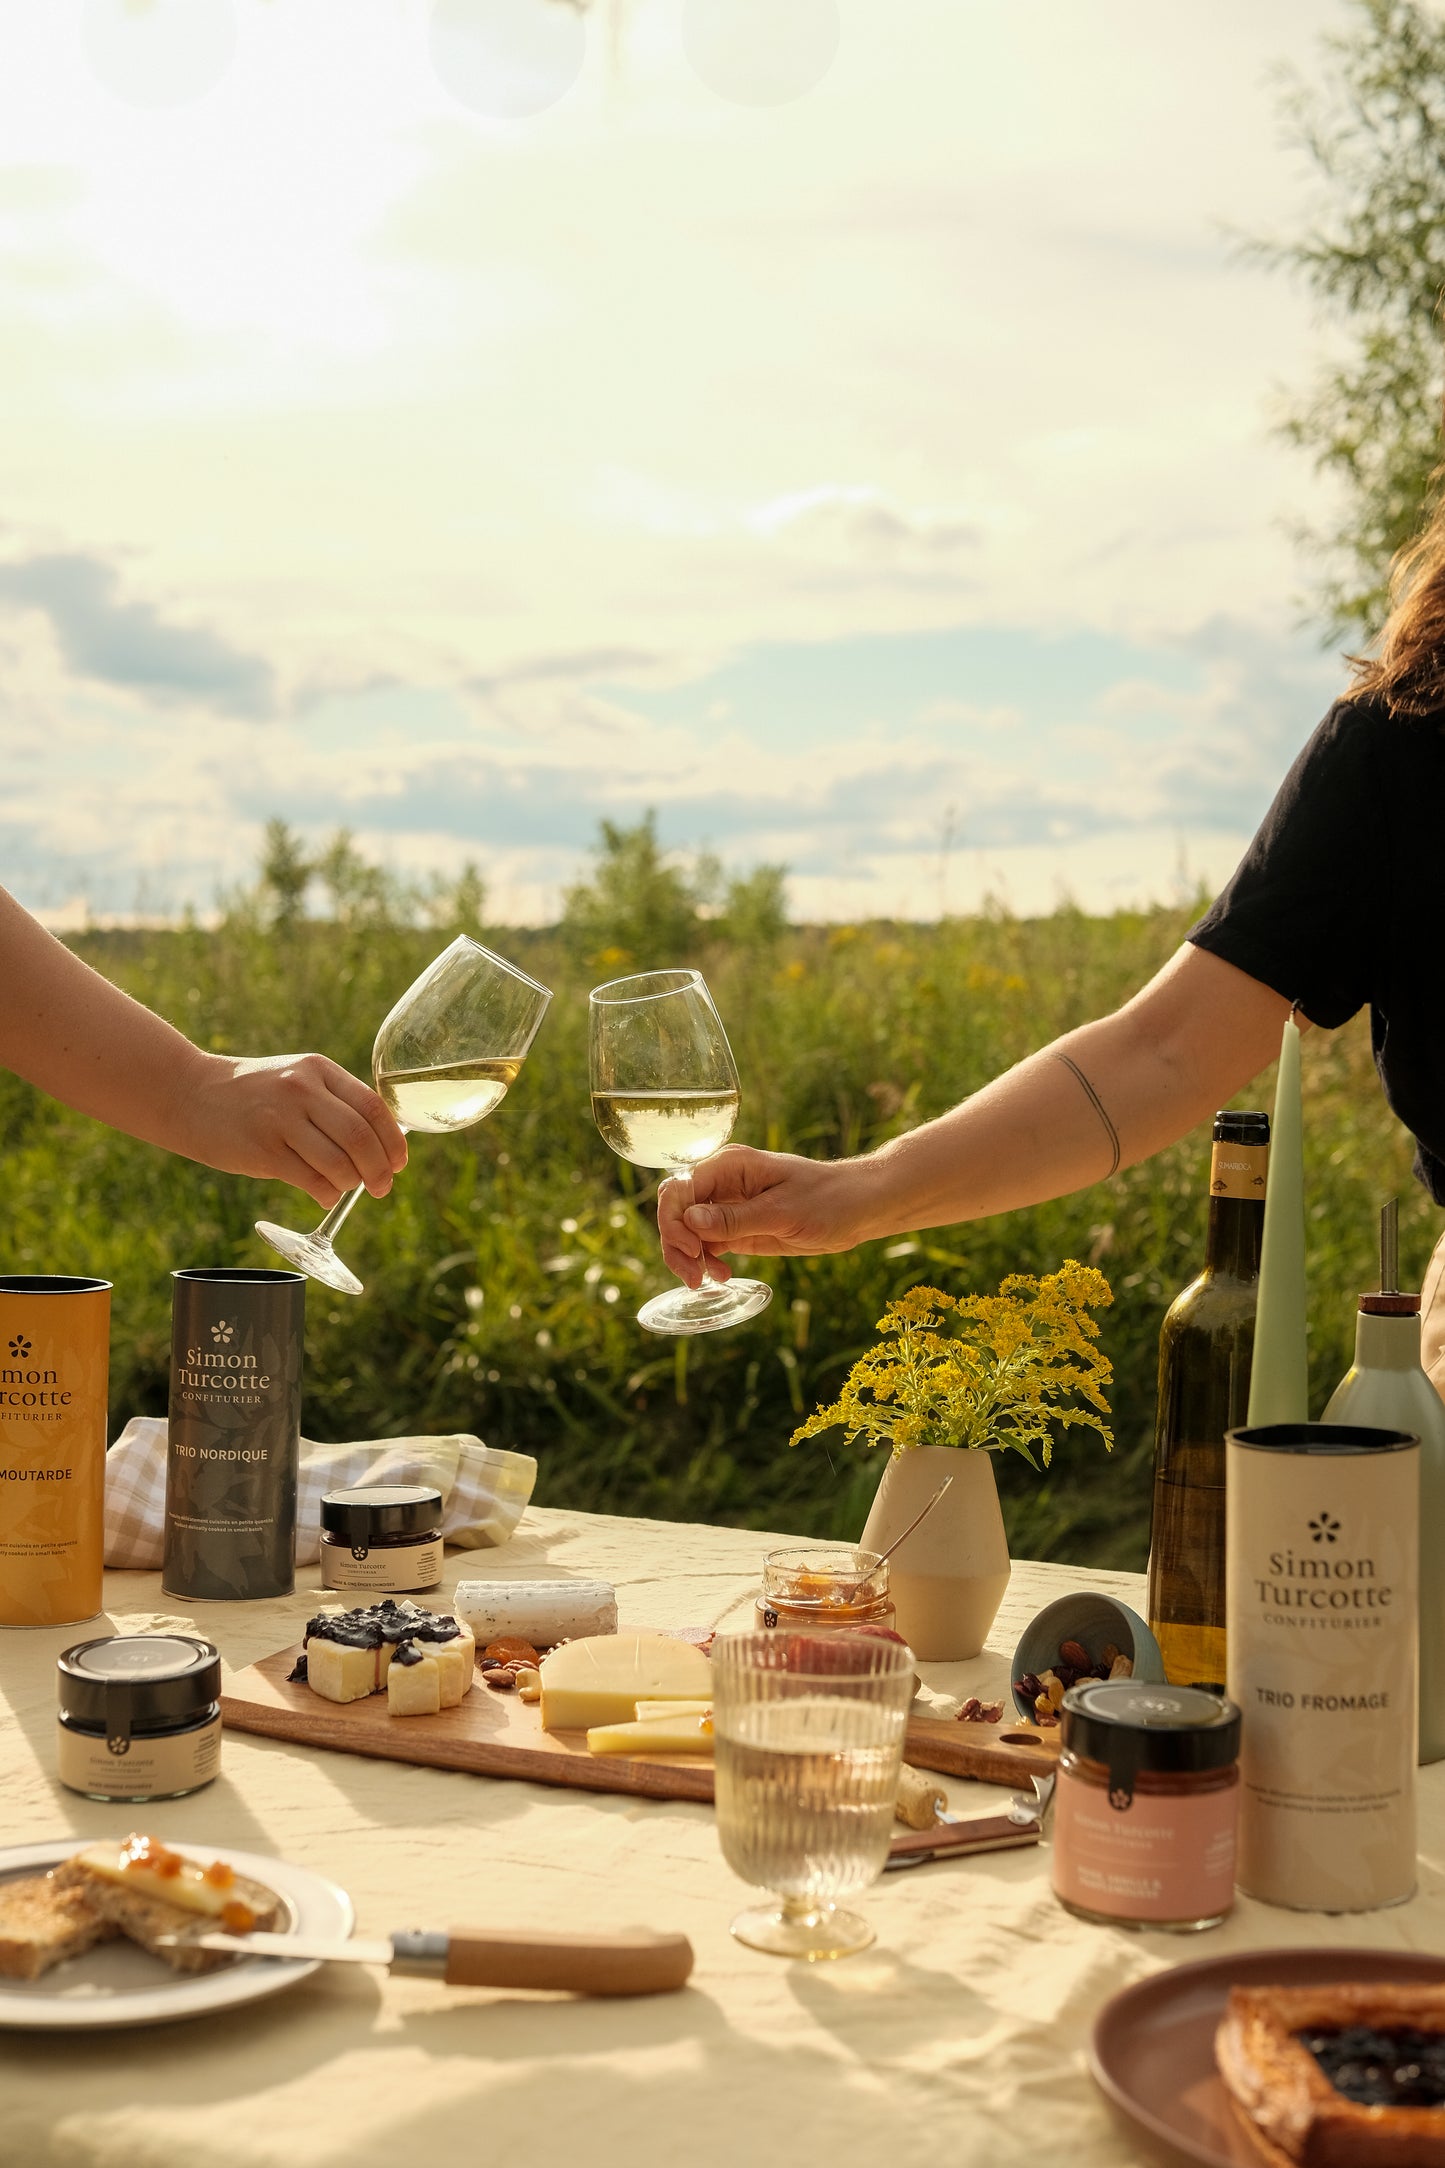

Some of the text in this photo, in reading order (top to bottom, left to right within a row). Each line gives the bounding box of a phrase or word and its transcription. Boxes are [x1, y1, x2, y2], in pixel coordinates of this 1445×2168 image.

[186, 1347, 258, 1369] Simon
[179, 1369, 271, 1390] Turcotte
[182, 1391, 261, 1404] CONFITURIER
[175, 1444, 268, 1463] TRIO NORDIQUE
[0, 1469, 72, 1481] MOUTARDE
[1269, 1550, 1375, 1579] Simon
[1254, 1579, 1392, 1609] Turcotte
[1263, 1613, 1381, 1629] CONFITURIER
[1256, 1687, 1389, 1712] TRIO FROMAGE
